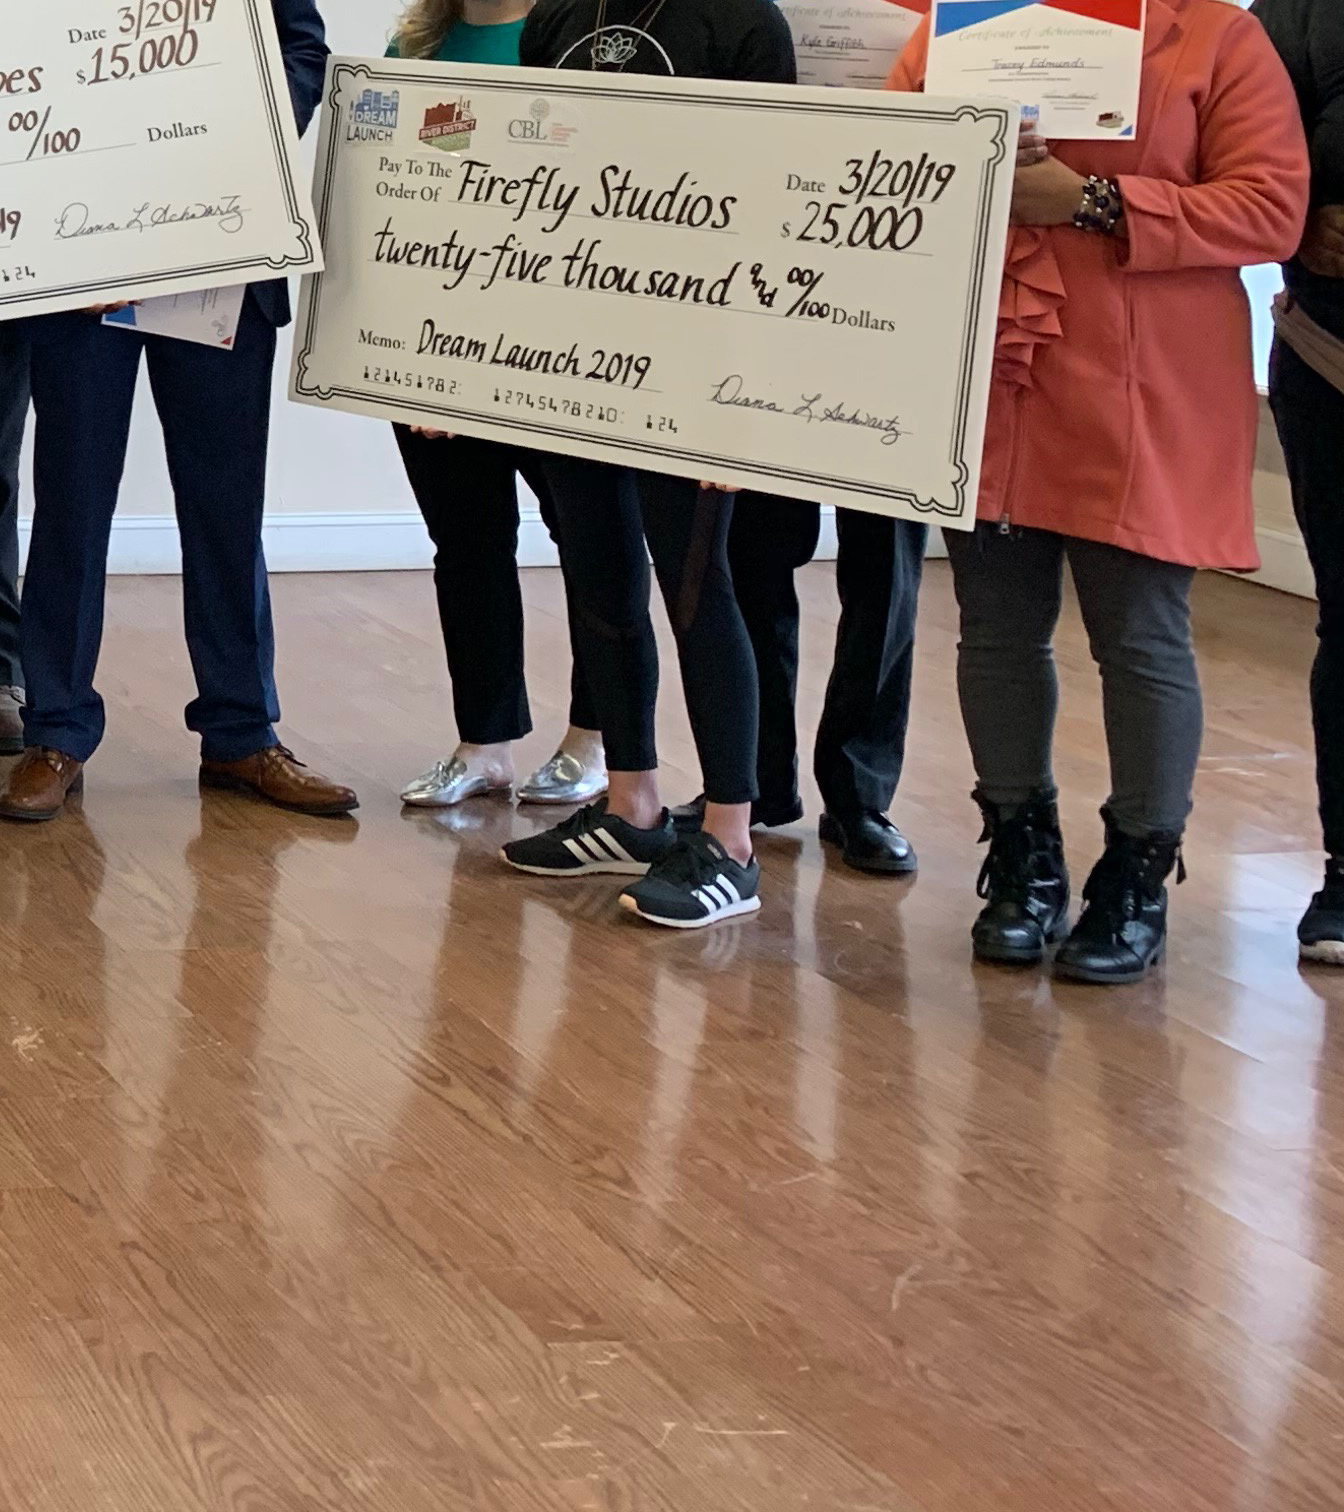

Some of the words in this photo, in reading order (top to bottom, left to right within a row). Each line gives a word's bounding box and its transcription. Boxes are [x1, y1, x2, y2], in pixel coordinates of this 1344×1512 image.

[68, 28, 107, 43] Date
[76, 69, 86, 84] $
[87, 29, 198, 86] 15,000
[1029, 57, 1085, 69] Edmunds
[355, 110, 396, 127] DREAM
[508, 119, 547, 140] CBL
[147, 122, 208, 143] Dollars
[346, 124, 393, 142] LAUNCH
[378, 156, 402, 174] Pay
[406, 159, 423, 176] To
[427, 161, 453, 179] The
[786, 173, 826, 193] Date
[838, 149, 956, 209] 3/20/19
[376, 181, 417, 201] Order
[420, 186, 442, 202] Of
[458, 159, 580, 233] Firefly
[591, 164, 738, 230] Studios
[780, 221, 791, 239] $
[796, 201, 924, 251] 25,000
[374, 216, 553, 291] twenty-five
[561, 238, 743, 307] thousand
[749, 262, 779, 308] and
[831, 307, 896, 333] Dollars
[357, 328, 407, 351] Memo:
[416, 318, 487, 363] Dream
[490, 333, 581, 378] Launch
[585, 349, 651, 390] 2019
